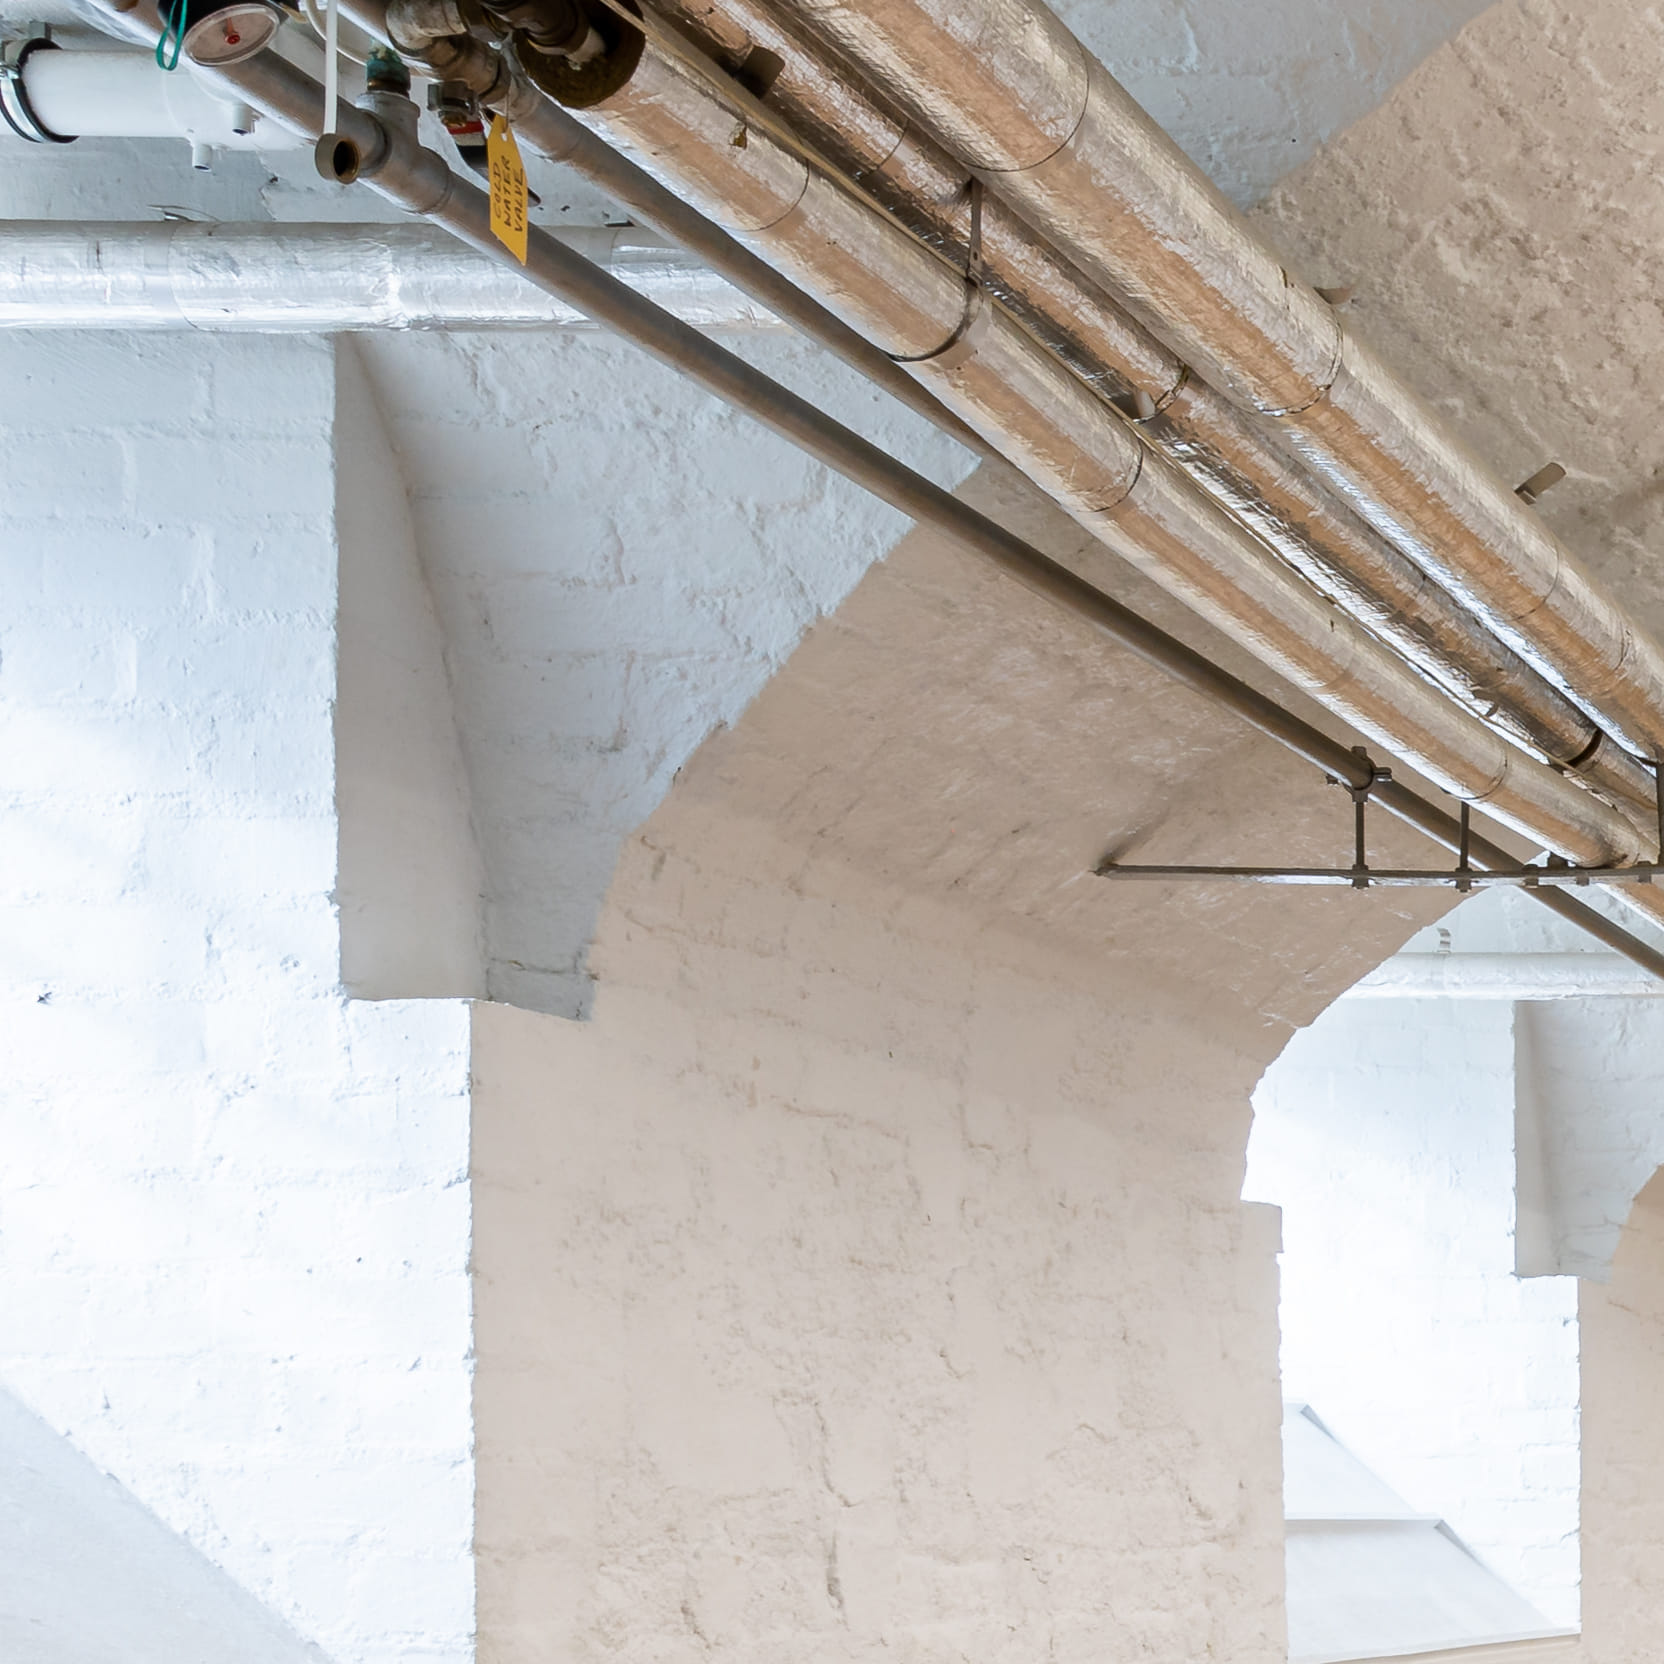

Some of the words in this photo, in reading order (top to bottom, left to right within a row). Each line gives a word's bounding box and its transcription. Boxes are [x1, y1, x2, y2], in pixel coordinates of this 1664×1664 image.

[493, 162, 502, 219] COLD
[502, 155, 512, 227] WATER
[514, 167, 524, 232] VALVE
